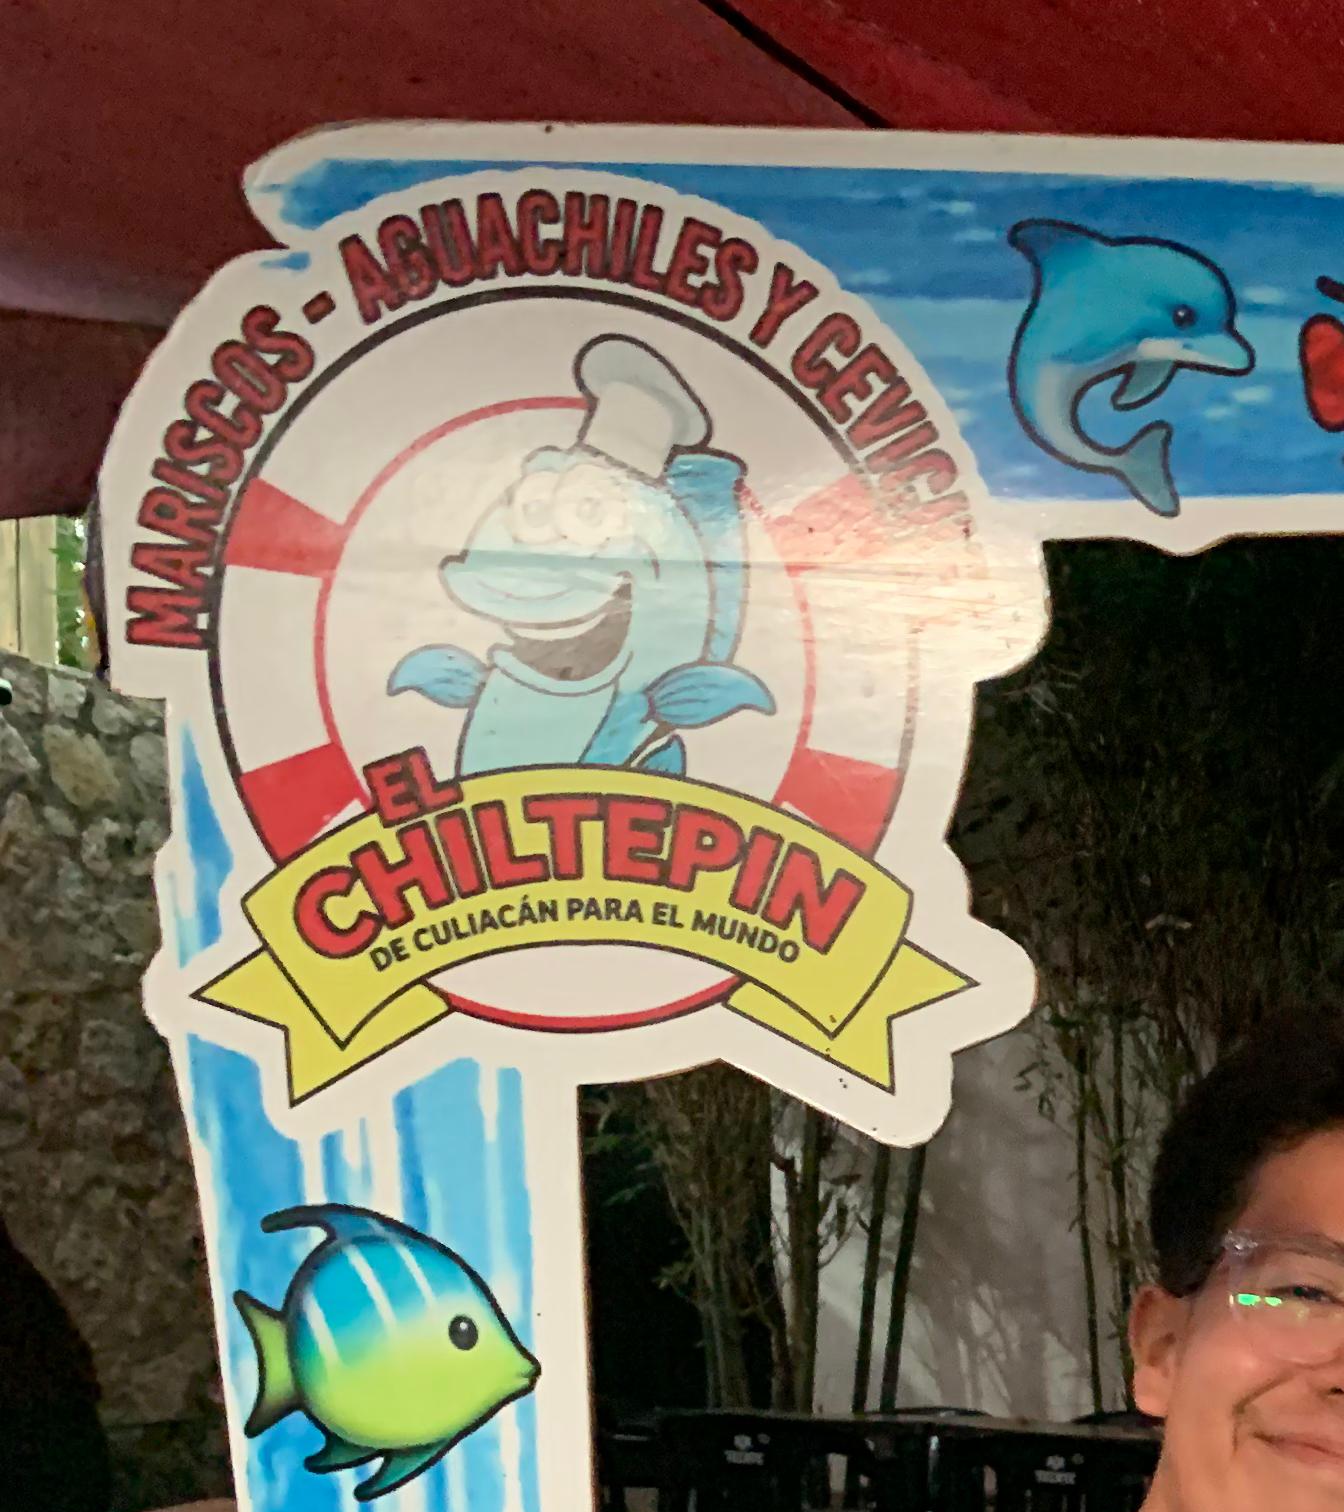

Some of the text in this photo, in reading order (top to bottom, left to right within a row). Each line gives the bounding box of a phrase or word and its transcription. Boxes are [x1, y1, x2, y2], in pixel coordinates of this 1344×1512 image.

[127, 305, 314, 649] MARISCOS
[338, 188, 758, 326] AGUACHILES
[750, 263, 818, 350] Y
[791, 312, 978, 545] CEVIC
[363, 746, 463, 827] EL
[293, 792, 866, 960] CHILTEPIN
[369, 895, 801, 972] DE CULIACÁN PARA EL MUNDO
